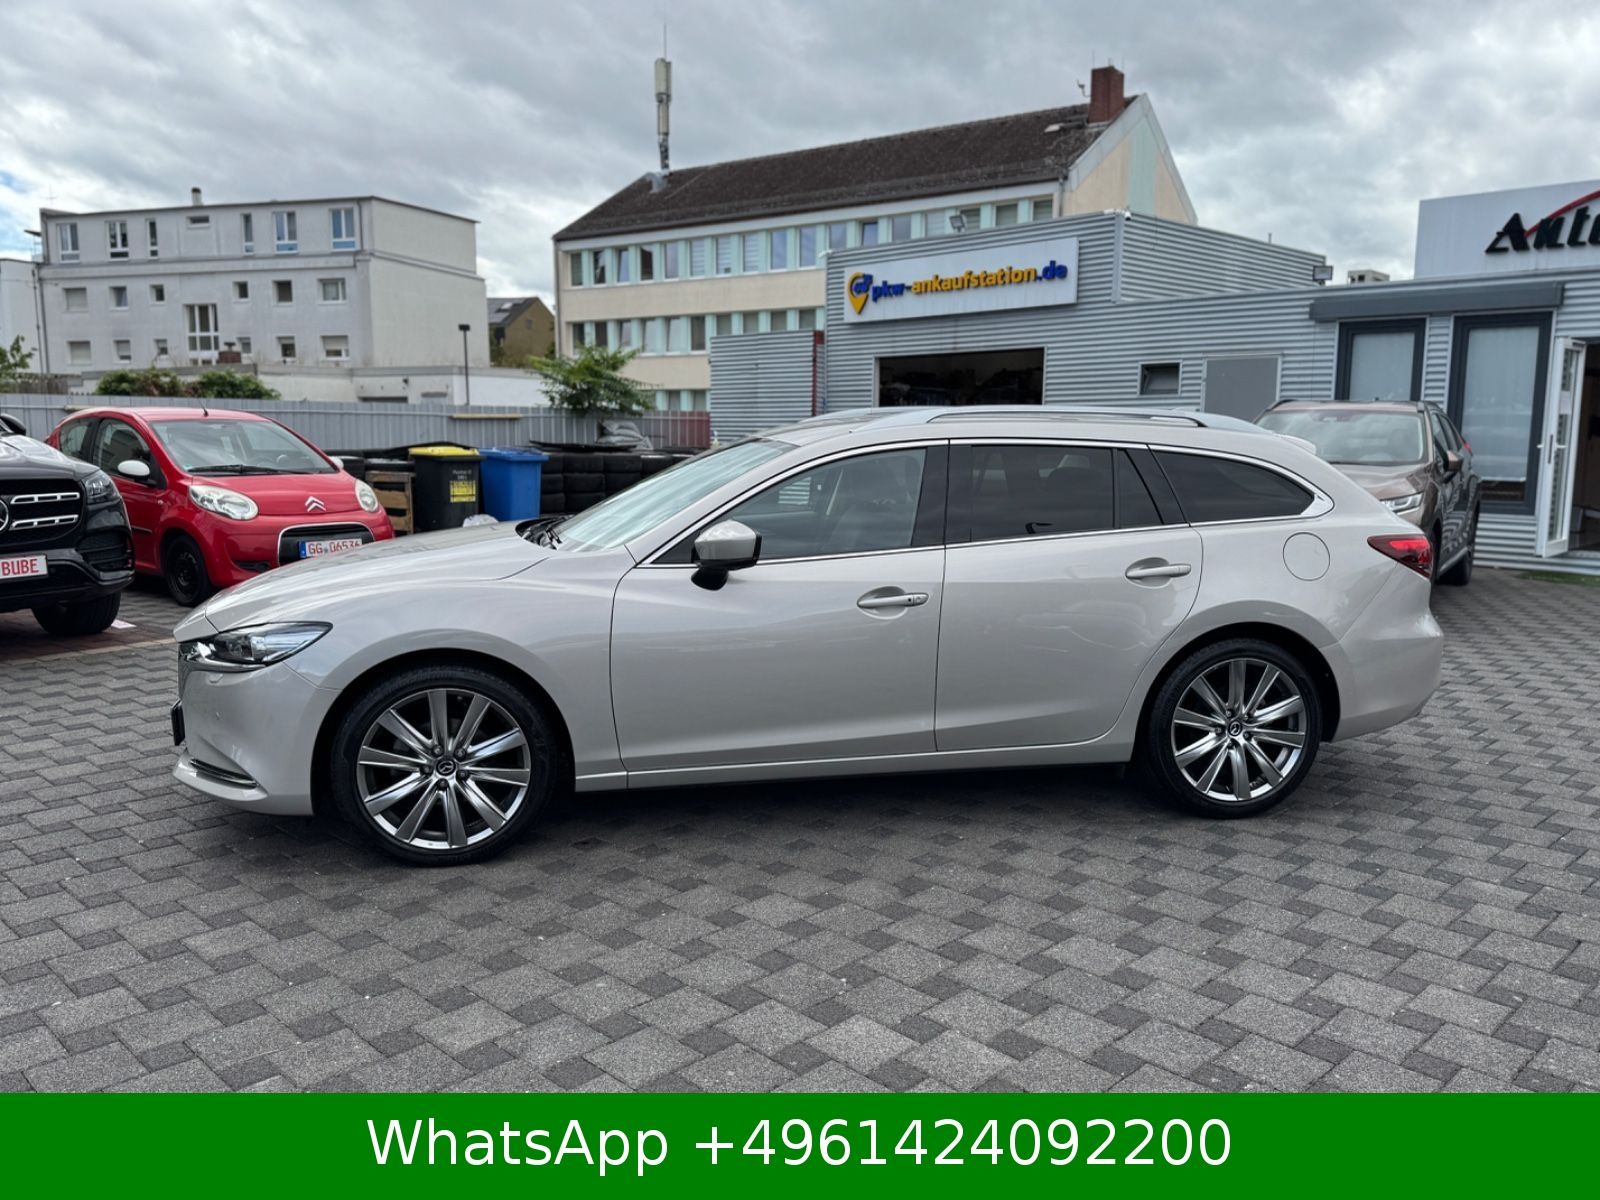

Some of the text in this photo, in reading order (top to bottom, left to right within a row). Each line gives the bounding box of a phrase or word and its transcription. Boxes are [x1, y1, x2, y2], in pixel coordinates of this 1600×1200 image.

[872, 260, 1068, 303] pkw-ankaufstation.de
[308, 543, 324, 555] GG
[1, 558, 39, 577] BUBE
